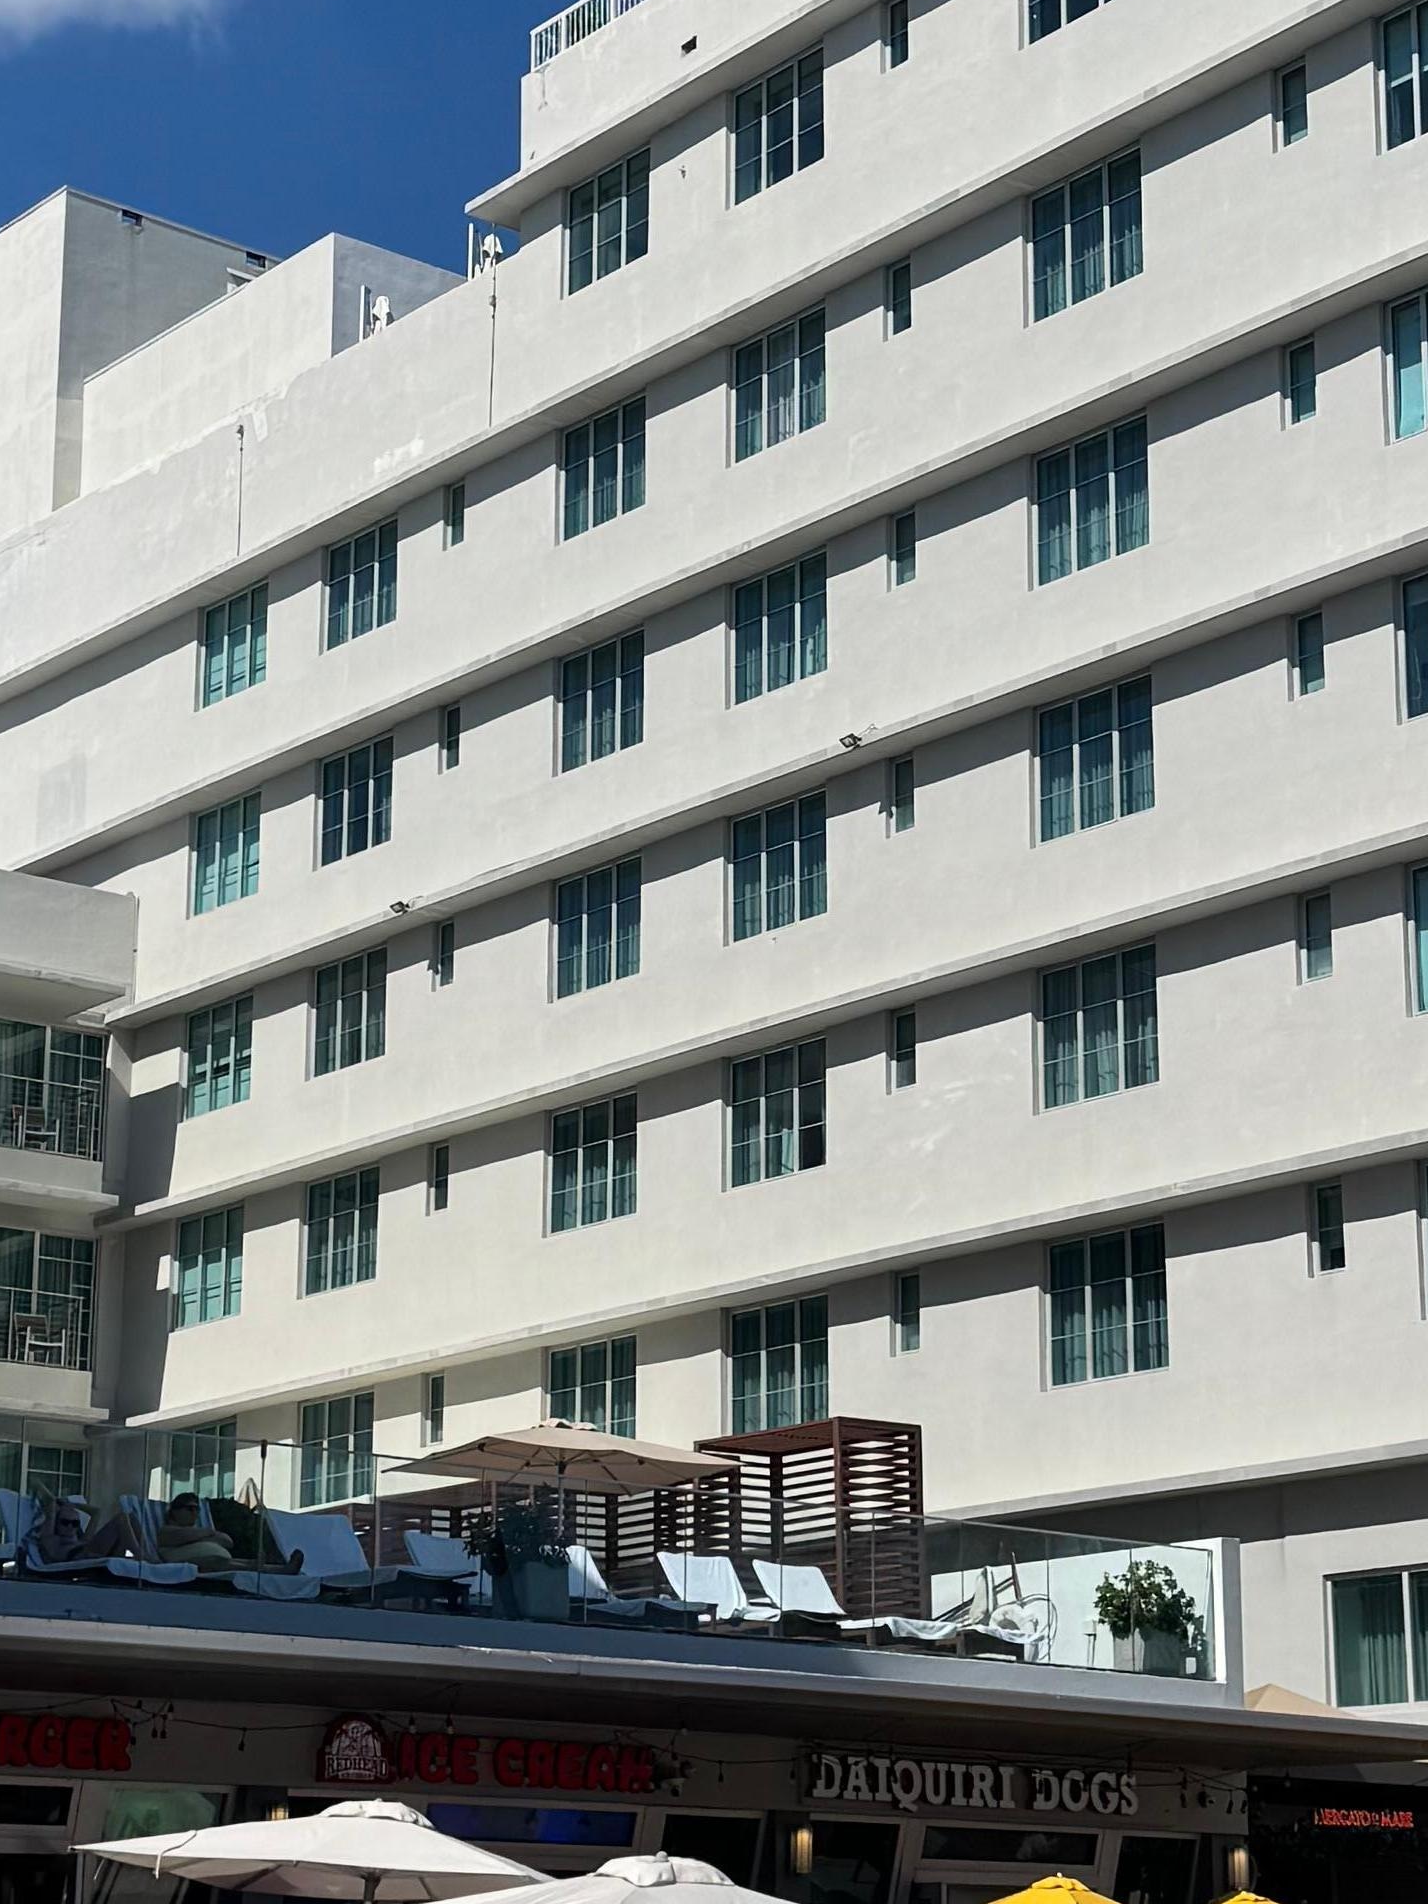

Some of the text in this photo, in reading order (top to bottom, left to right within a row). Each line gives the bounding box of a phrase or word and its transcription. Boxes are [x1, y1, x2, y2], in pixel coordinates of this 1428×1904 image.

[398, 1732, 655, 1794] ICE CREAM
[811, 1753, 1139, 1816] DAIQUIRI DOGS
